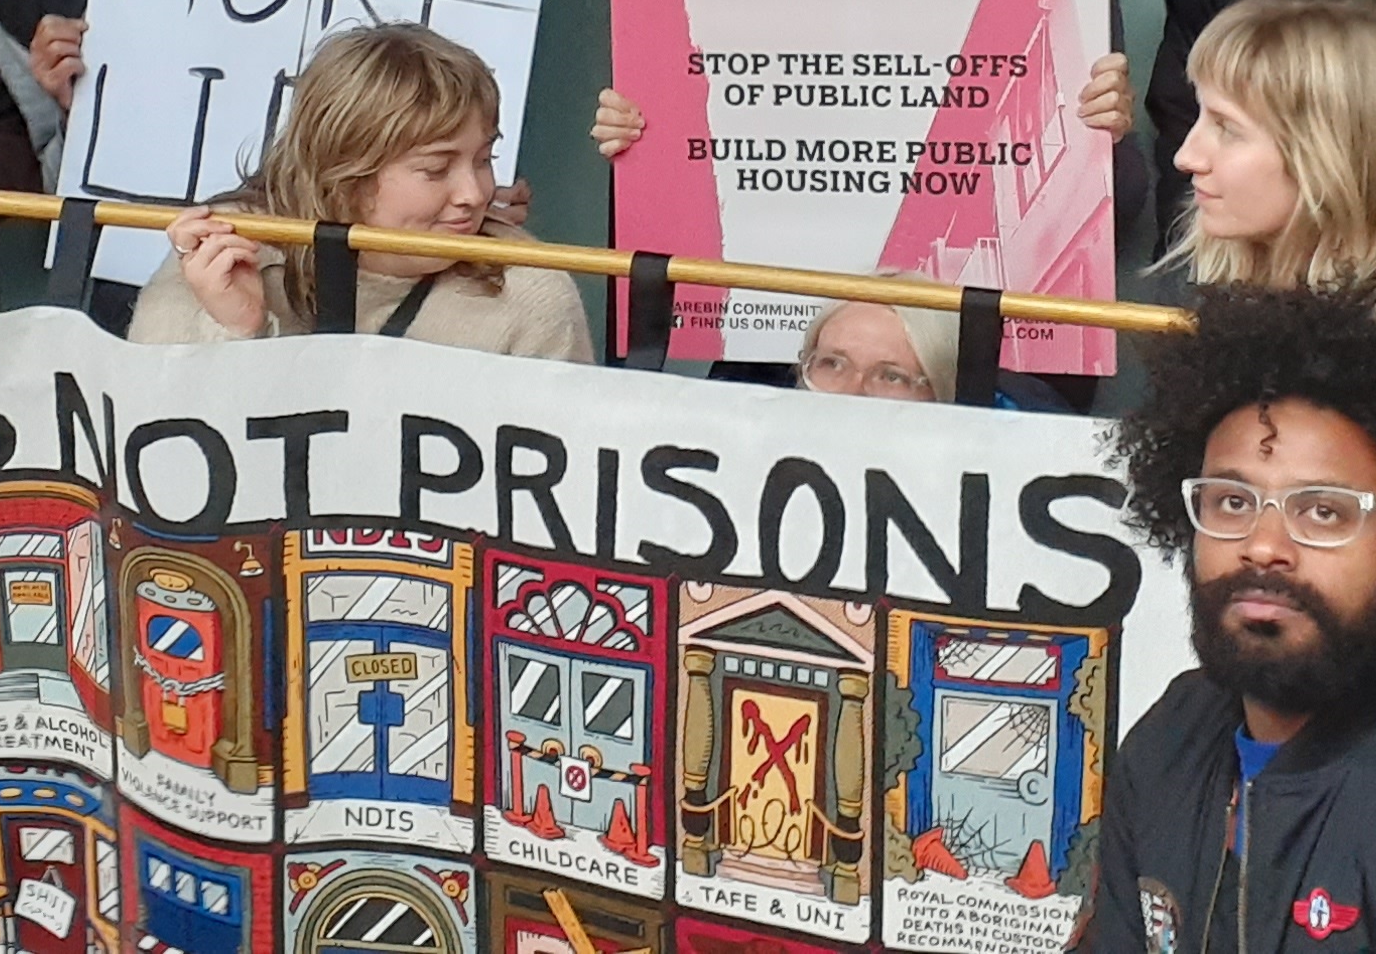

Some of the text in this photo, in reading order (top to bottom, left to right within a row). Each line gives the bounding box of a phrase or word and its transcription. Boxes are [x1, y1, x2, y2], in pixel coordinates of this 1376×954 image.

[687, 53, 1029, 79] STOP THE SELL-OFFS
[723, 84, 991, 109] OF PUBLIC LAND
[687, 139, 1033, 167] BUILD MORE PUBLIC
[736, 169, 981, 195] HOUSING NOW
[674, 301, 823, 316] AREBIN COMMUNIT
[690, 316, 811, 332] FIND US ON FAC
[53, 371, 351, 528] NOT
[400, 412, 1143, 621] PRISONS
[351, 658, 413, 676] CLOSED
[14, 714, 29, 731] &
[35, 716, 109, 749] ALCOHOL
[344, 807, 415, 832] NDIS
[508, 841, 639, 886] CHILDCARE
[699, 886, 846, 931] TAFE & UNI
[897, 887, 1079, 924] ROYAL COMMISSION
[903, 918, 964, 934] DEATHS
[970, 927, 988, 938] IN
[907, 905, 1065, 936] INTO ABORIGINAL
